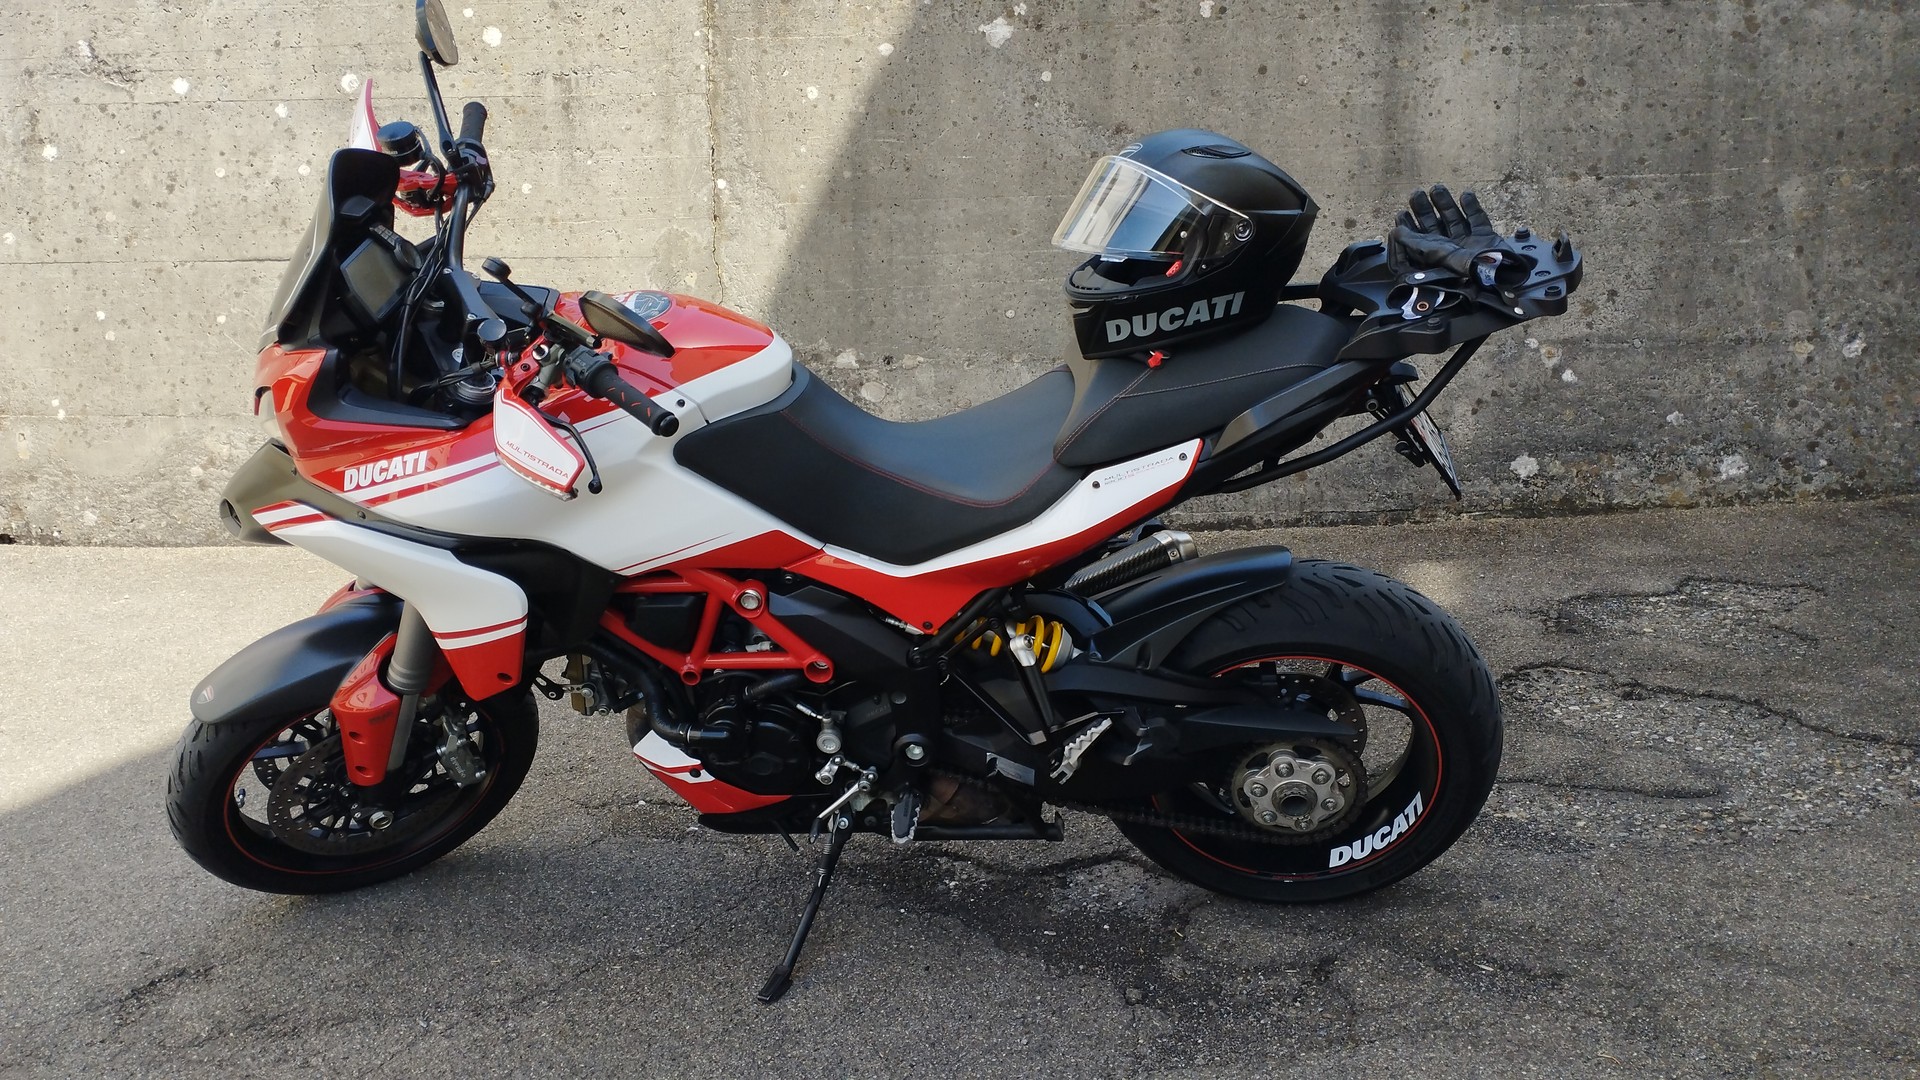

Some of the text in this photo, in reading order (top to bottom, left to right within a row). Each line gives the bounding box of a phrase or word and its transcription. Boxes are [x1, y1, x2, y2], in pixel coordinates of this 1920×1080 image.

[1105, 291, 1246, 343] DUCATI
[343, 450, 429, 492] DUCATI
[505, 440, 569, 479] MULTISTRADA
[1328, 791, 1424, 869] DUCATI
